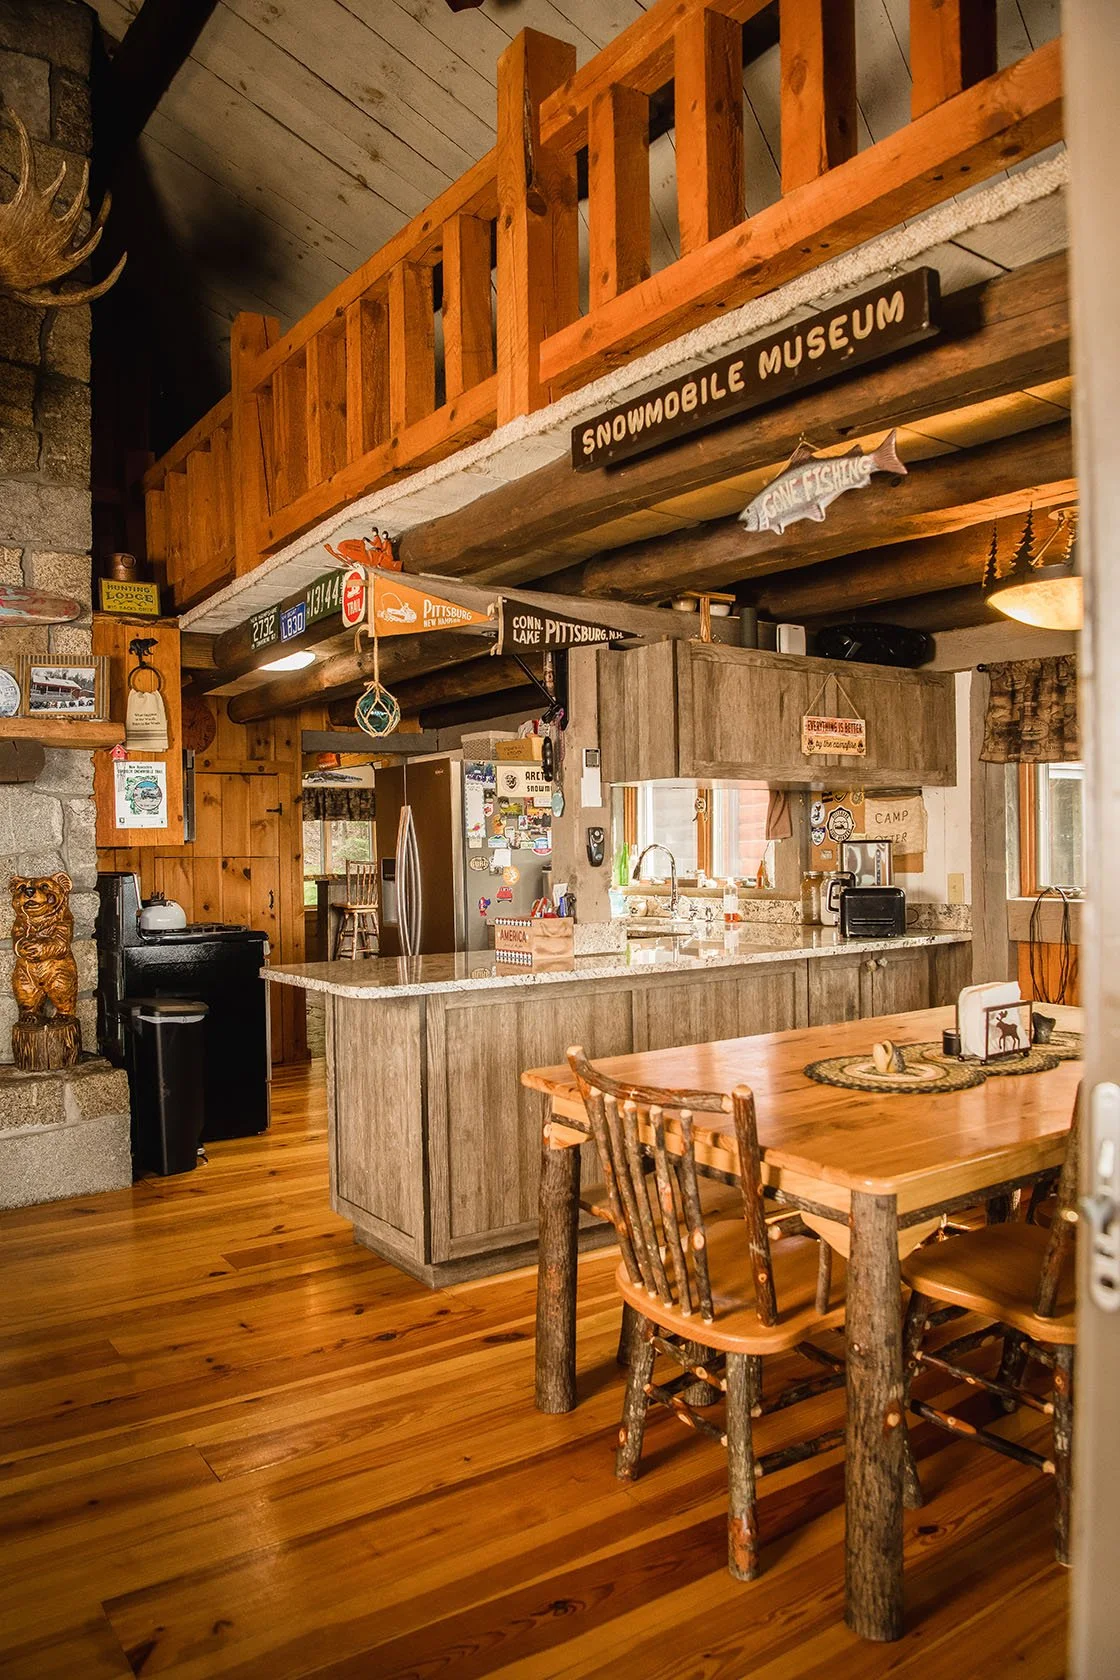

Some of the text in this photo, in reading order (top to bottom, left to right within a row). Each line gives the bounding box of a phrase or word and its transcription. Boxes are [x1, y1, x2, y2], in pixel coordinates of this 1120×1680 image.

[582, 290, 905, 455] SNOWMOBILE MUSEUM
[762, 455, 872, 518] GONE FISHING
[107, 584, 150, 593] HUNTING
[105, 592, 153, 603] LODGE
[423, 599, 473, 621] PITTSBURG
[253, 614, 275, 642] 2732
[423, 618, 437, 628] NEW
[512, 615, 544, 631] CONN.
[513, 629, 541, 645] LAKE
[807, 720, 863, 734] EVERYTHING IS BETTER
[525, 771, 544, 780] ARCT
[874, 810, 909, 824] CAMP
[500, 929, 527, 943] AMERICA
